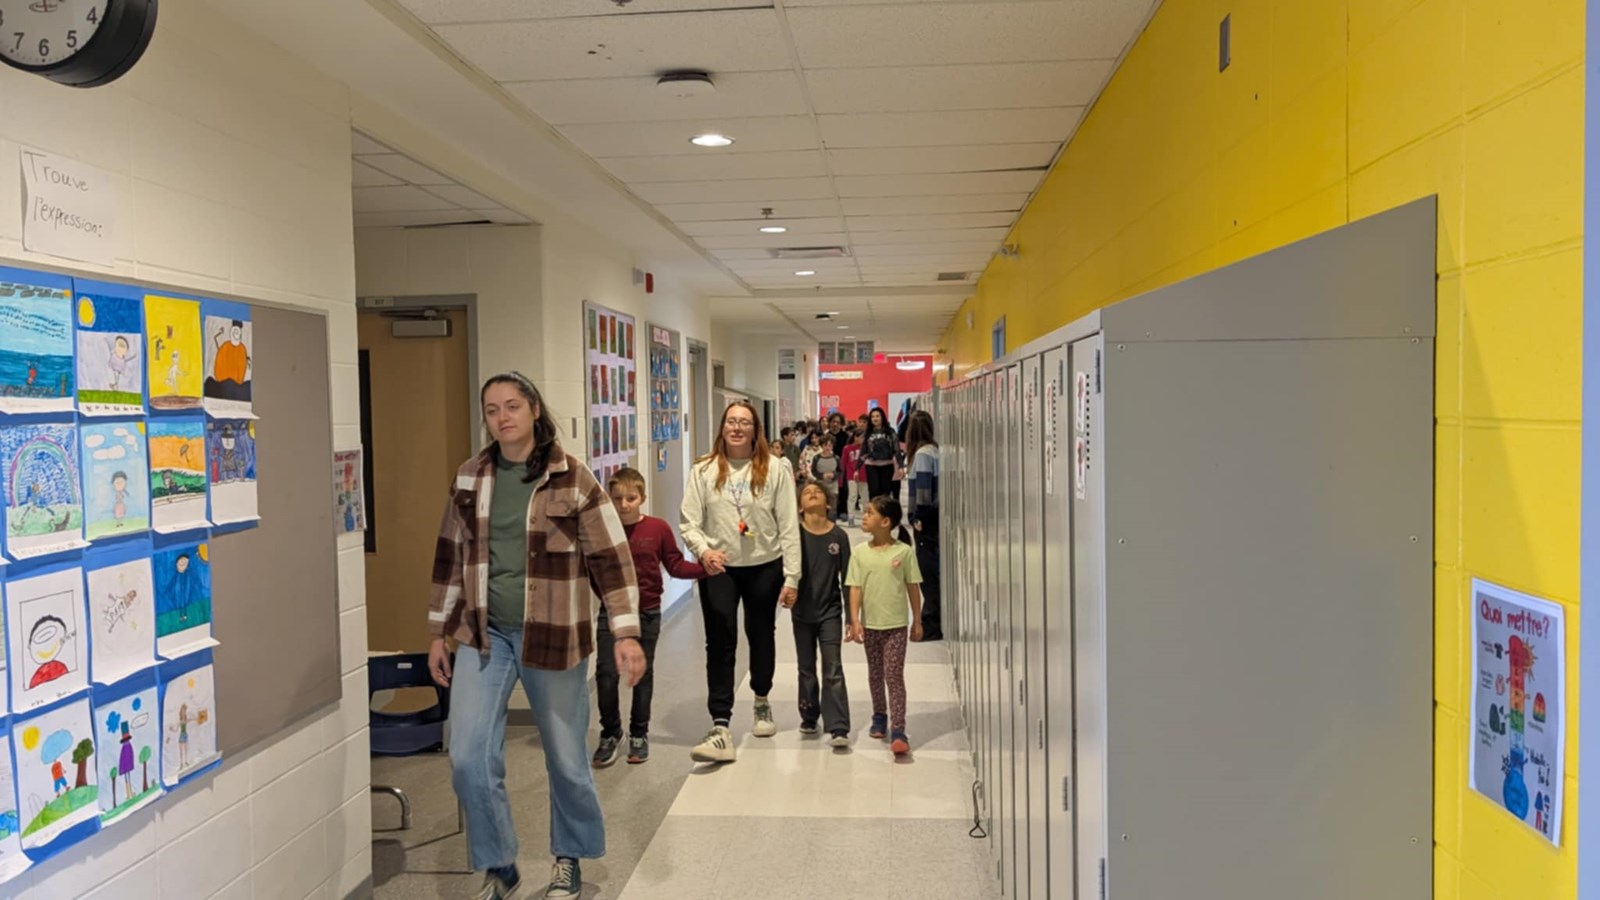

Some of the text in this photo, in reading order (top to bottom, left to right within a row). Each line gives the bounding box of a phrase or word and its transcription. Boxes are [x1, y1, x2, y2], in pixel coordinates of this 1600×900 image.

[86, 7, 98, 24] 4
[14, 32, 24, 50] 7
[39, 38, 49, 56] 6
[66, 30, 77, 48] 5
[24, 151, 88, 191] Trouve
[1481, 600, 1502, 624] Quoi
